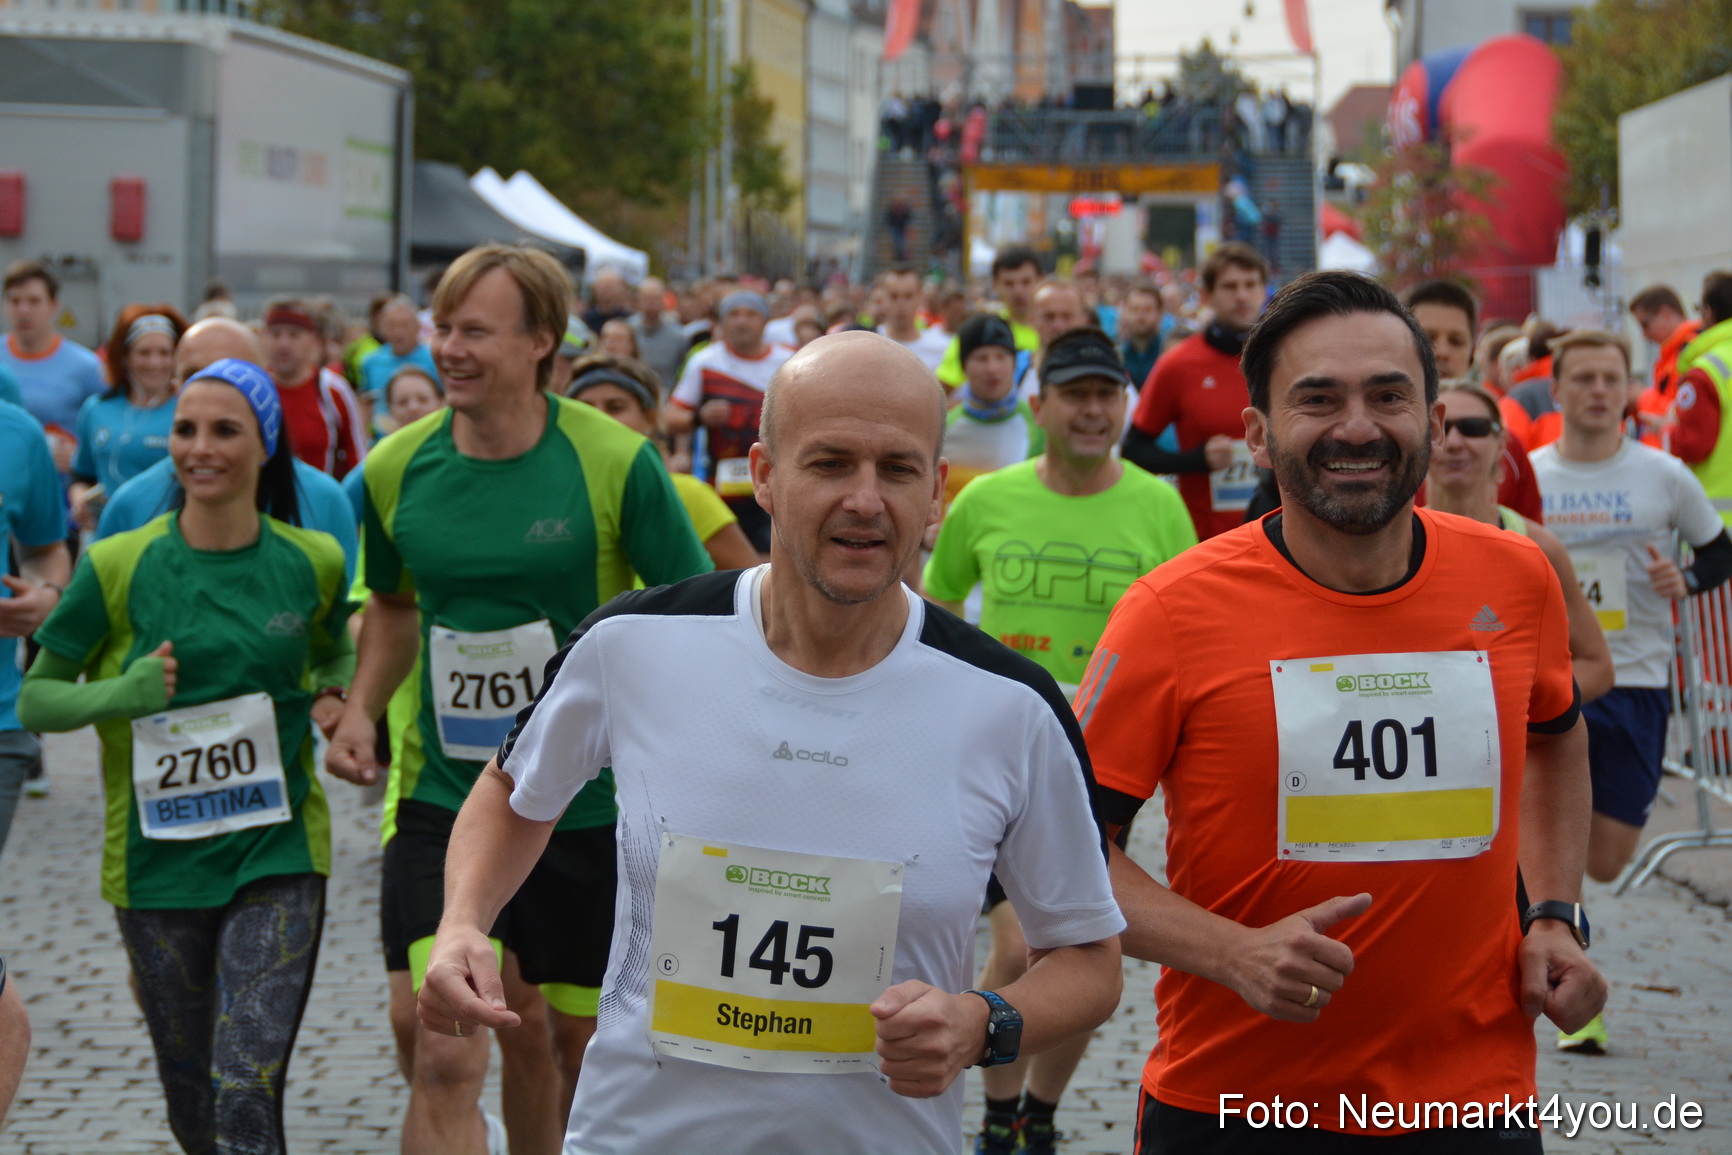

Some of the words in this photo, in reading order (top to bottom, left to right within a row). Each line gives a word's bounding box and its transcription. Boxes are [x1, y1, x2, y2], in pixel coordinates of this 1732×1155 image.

[1561, 490, 1630, 510] BANK
[523, 517, 571, 538] AOK
[1579, 580, 1602, 604] 4
[1469, 622, 1505, 632] adidas
[448, 666, 535, 710] 2761
[1357, 672, 1432, 691] BOCK
[796, 750, 849, 767] odlo
[1332, 716, 1438, 781] 401
[156, 738, 257, 790] 2760
[1291, 776, 1300, 788] D
[156, 785, 267, 822] BETTINA
[749, 867, 831, 895] BOCK
[748, 886, 773, 895] inspired
[784, 891, 801, 899] smart
[803, 894, 831, 903] concepts
[712, 913, 835, 989] 145
[663, 959, 672, 971] C
[716, 1003, 813, 1036] Stephan
